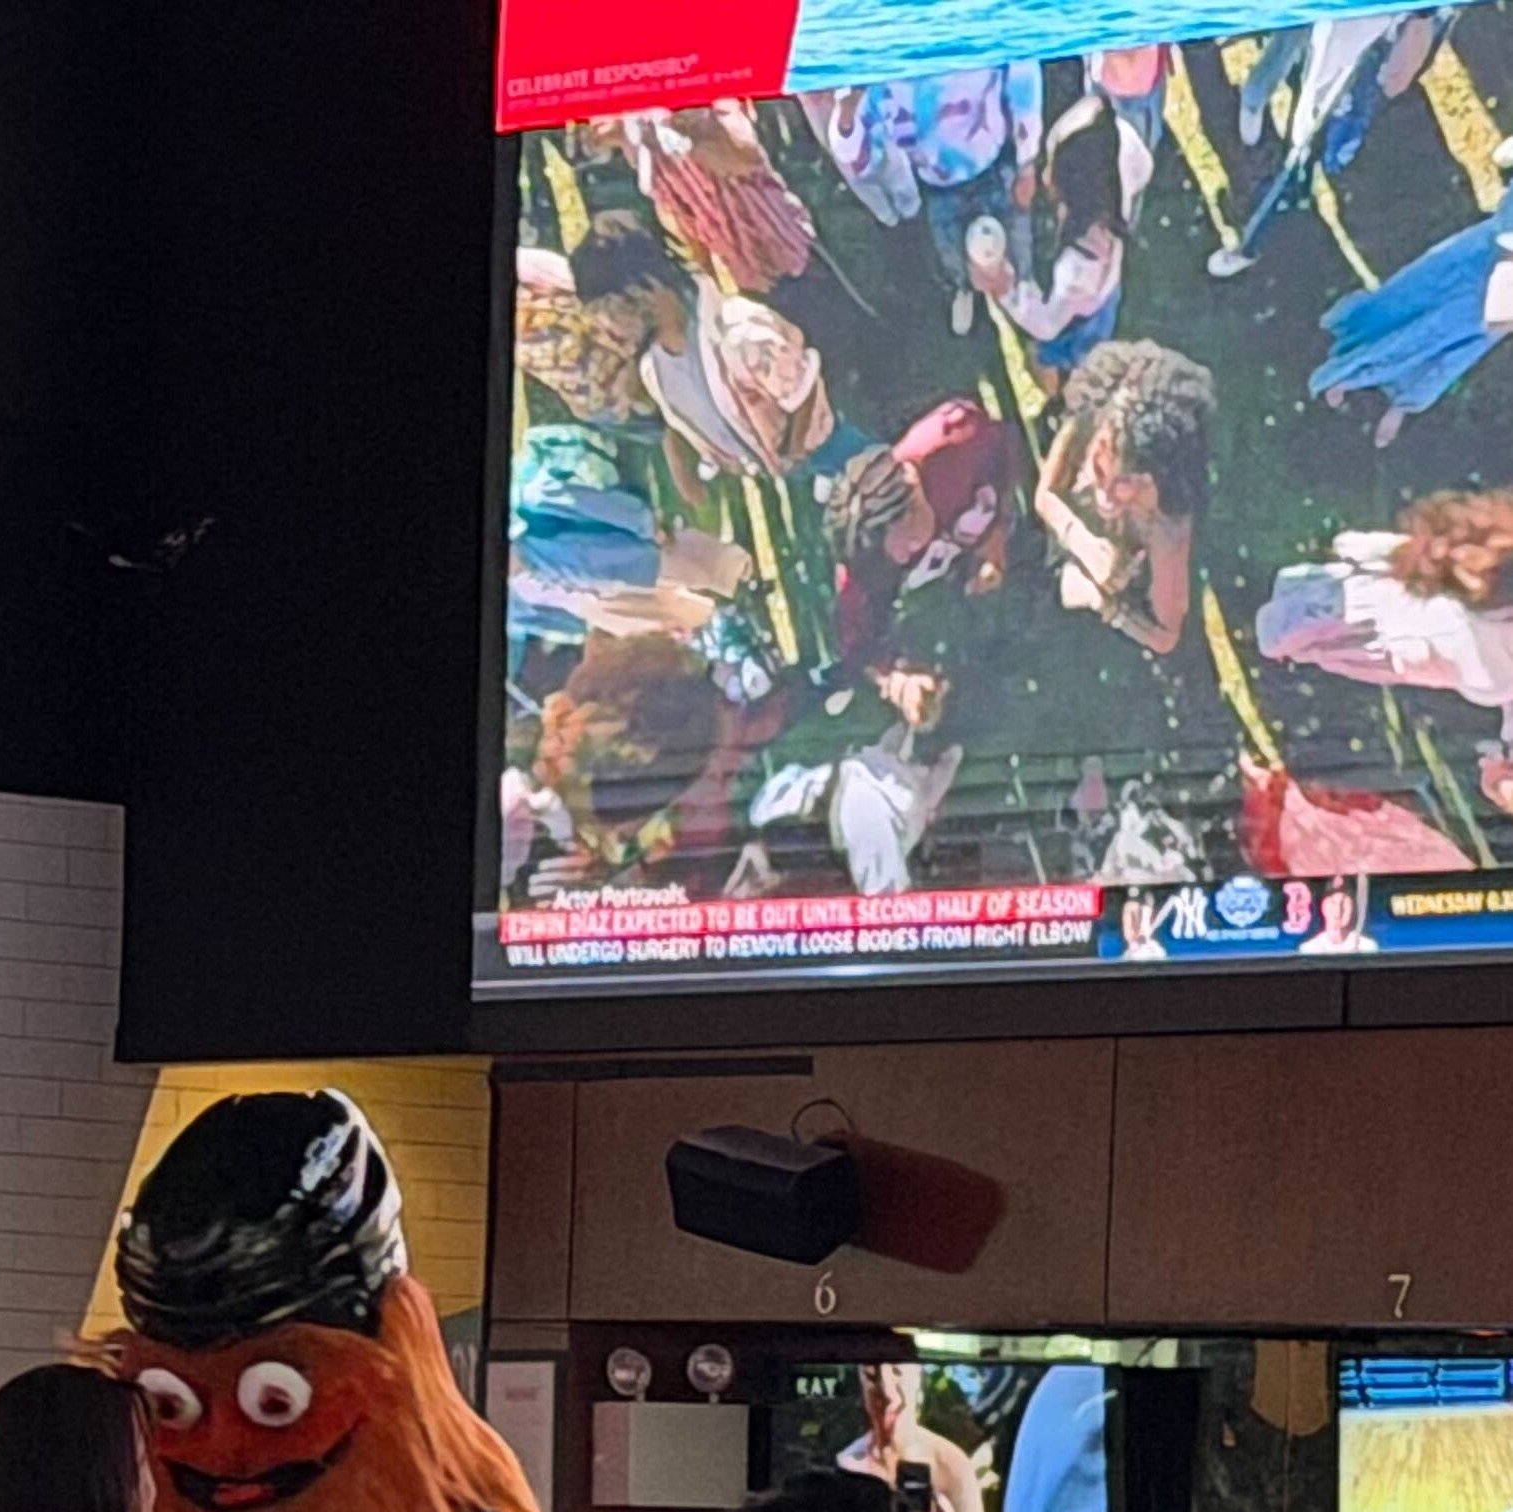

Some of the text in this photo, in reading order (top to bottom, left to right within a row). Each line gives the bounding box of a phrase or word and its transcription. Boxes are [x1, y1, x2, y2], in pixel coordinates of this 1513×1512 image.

[613, 904, 703, 934] EXPECTED
[706, 903, 730, 928] TO
[762, 900, 800, 926] OUT
[802, 900, 852, 927] UNTIL
[857, 895, 933, 922] SECOND
[937, 892, 982, 919] HALF
[986, 890, 1011, 917] OF
[1015, 886, 1095, 917] SEASON
[705, 933, 727, 958] TO
[800, 928, 854, 955] LOOSE
[857, 925, 920, 953] BODIES
[922, 922, 972, 950] FROM
[974, 921, 1026, 948] RIGHT
[1029, 919, 1092, 946] ELBOW
[813, 1271, 837, 1317] 6
[1388, 1273, 1413, 1319] 7
